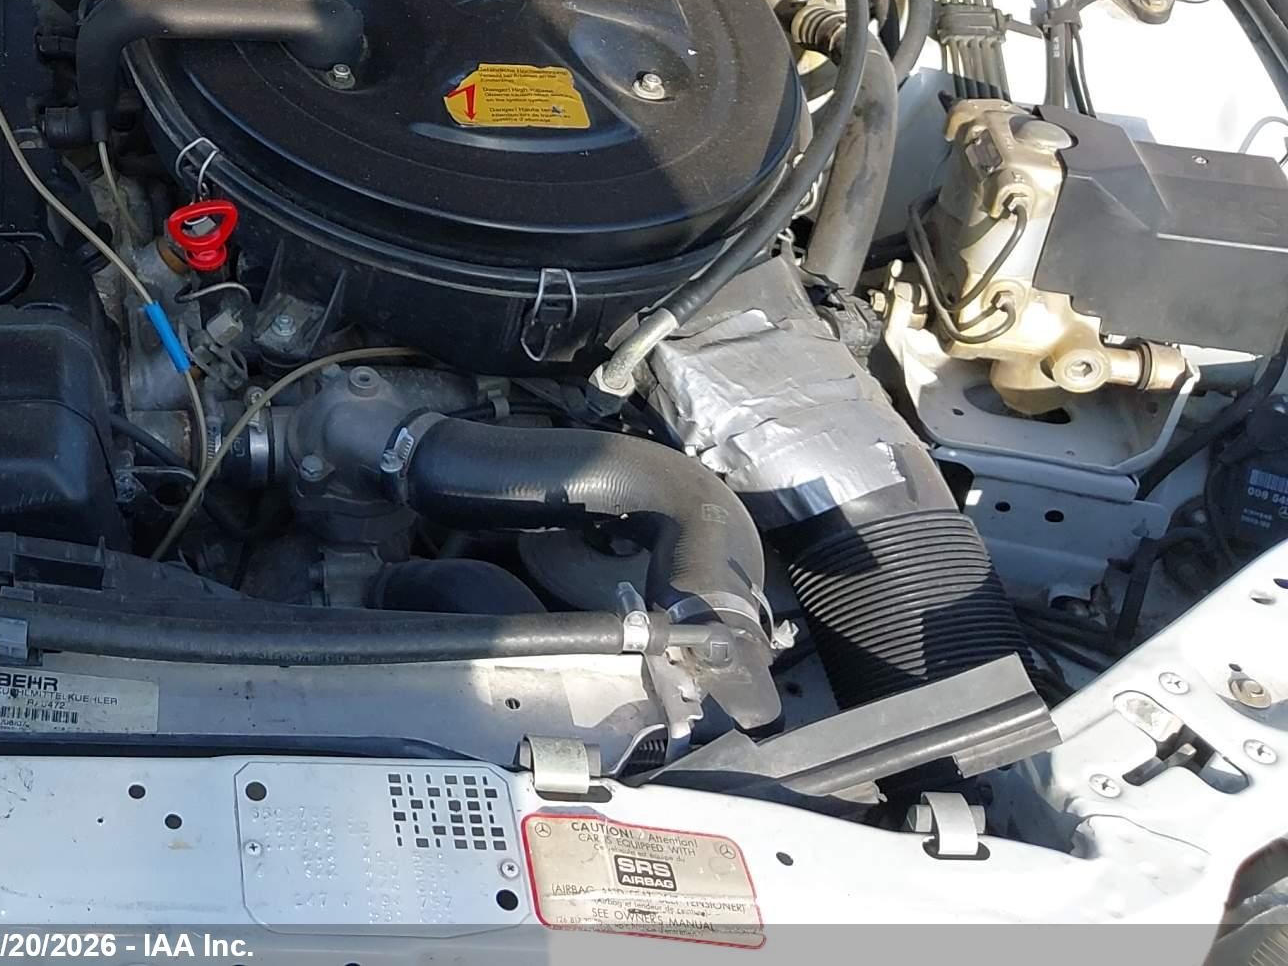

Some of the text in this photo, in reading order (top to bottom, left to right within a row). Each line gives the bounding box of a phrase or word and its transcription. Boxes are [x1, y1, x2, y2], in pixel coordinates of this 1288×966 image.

[571, 822, 633, 839] CAUTION!
[648, 833, 698, 848] Attention!
[578, 833, 600, 843] CAR
[616, 838, 664, 853] EQUIPPED
[669, 843, 696, 856] WITH
[617, 856, 671, 877] SRS
[621, 874, 674, 889] AIRBAG
[592, 908, 609, 919] SEE
[668, 918, 715, 932] MANUAL
